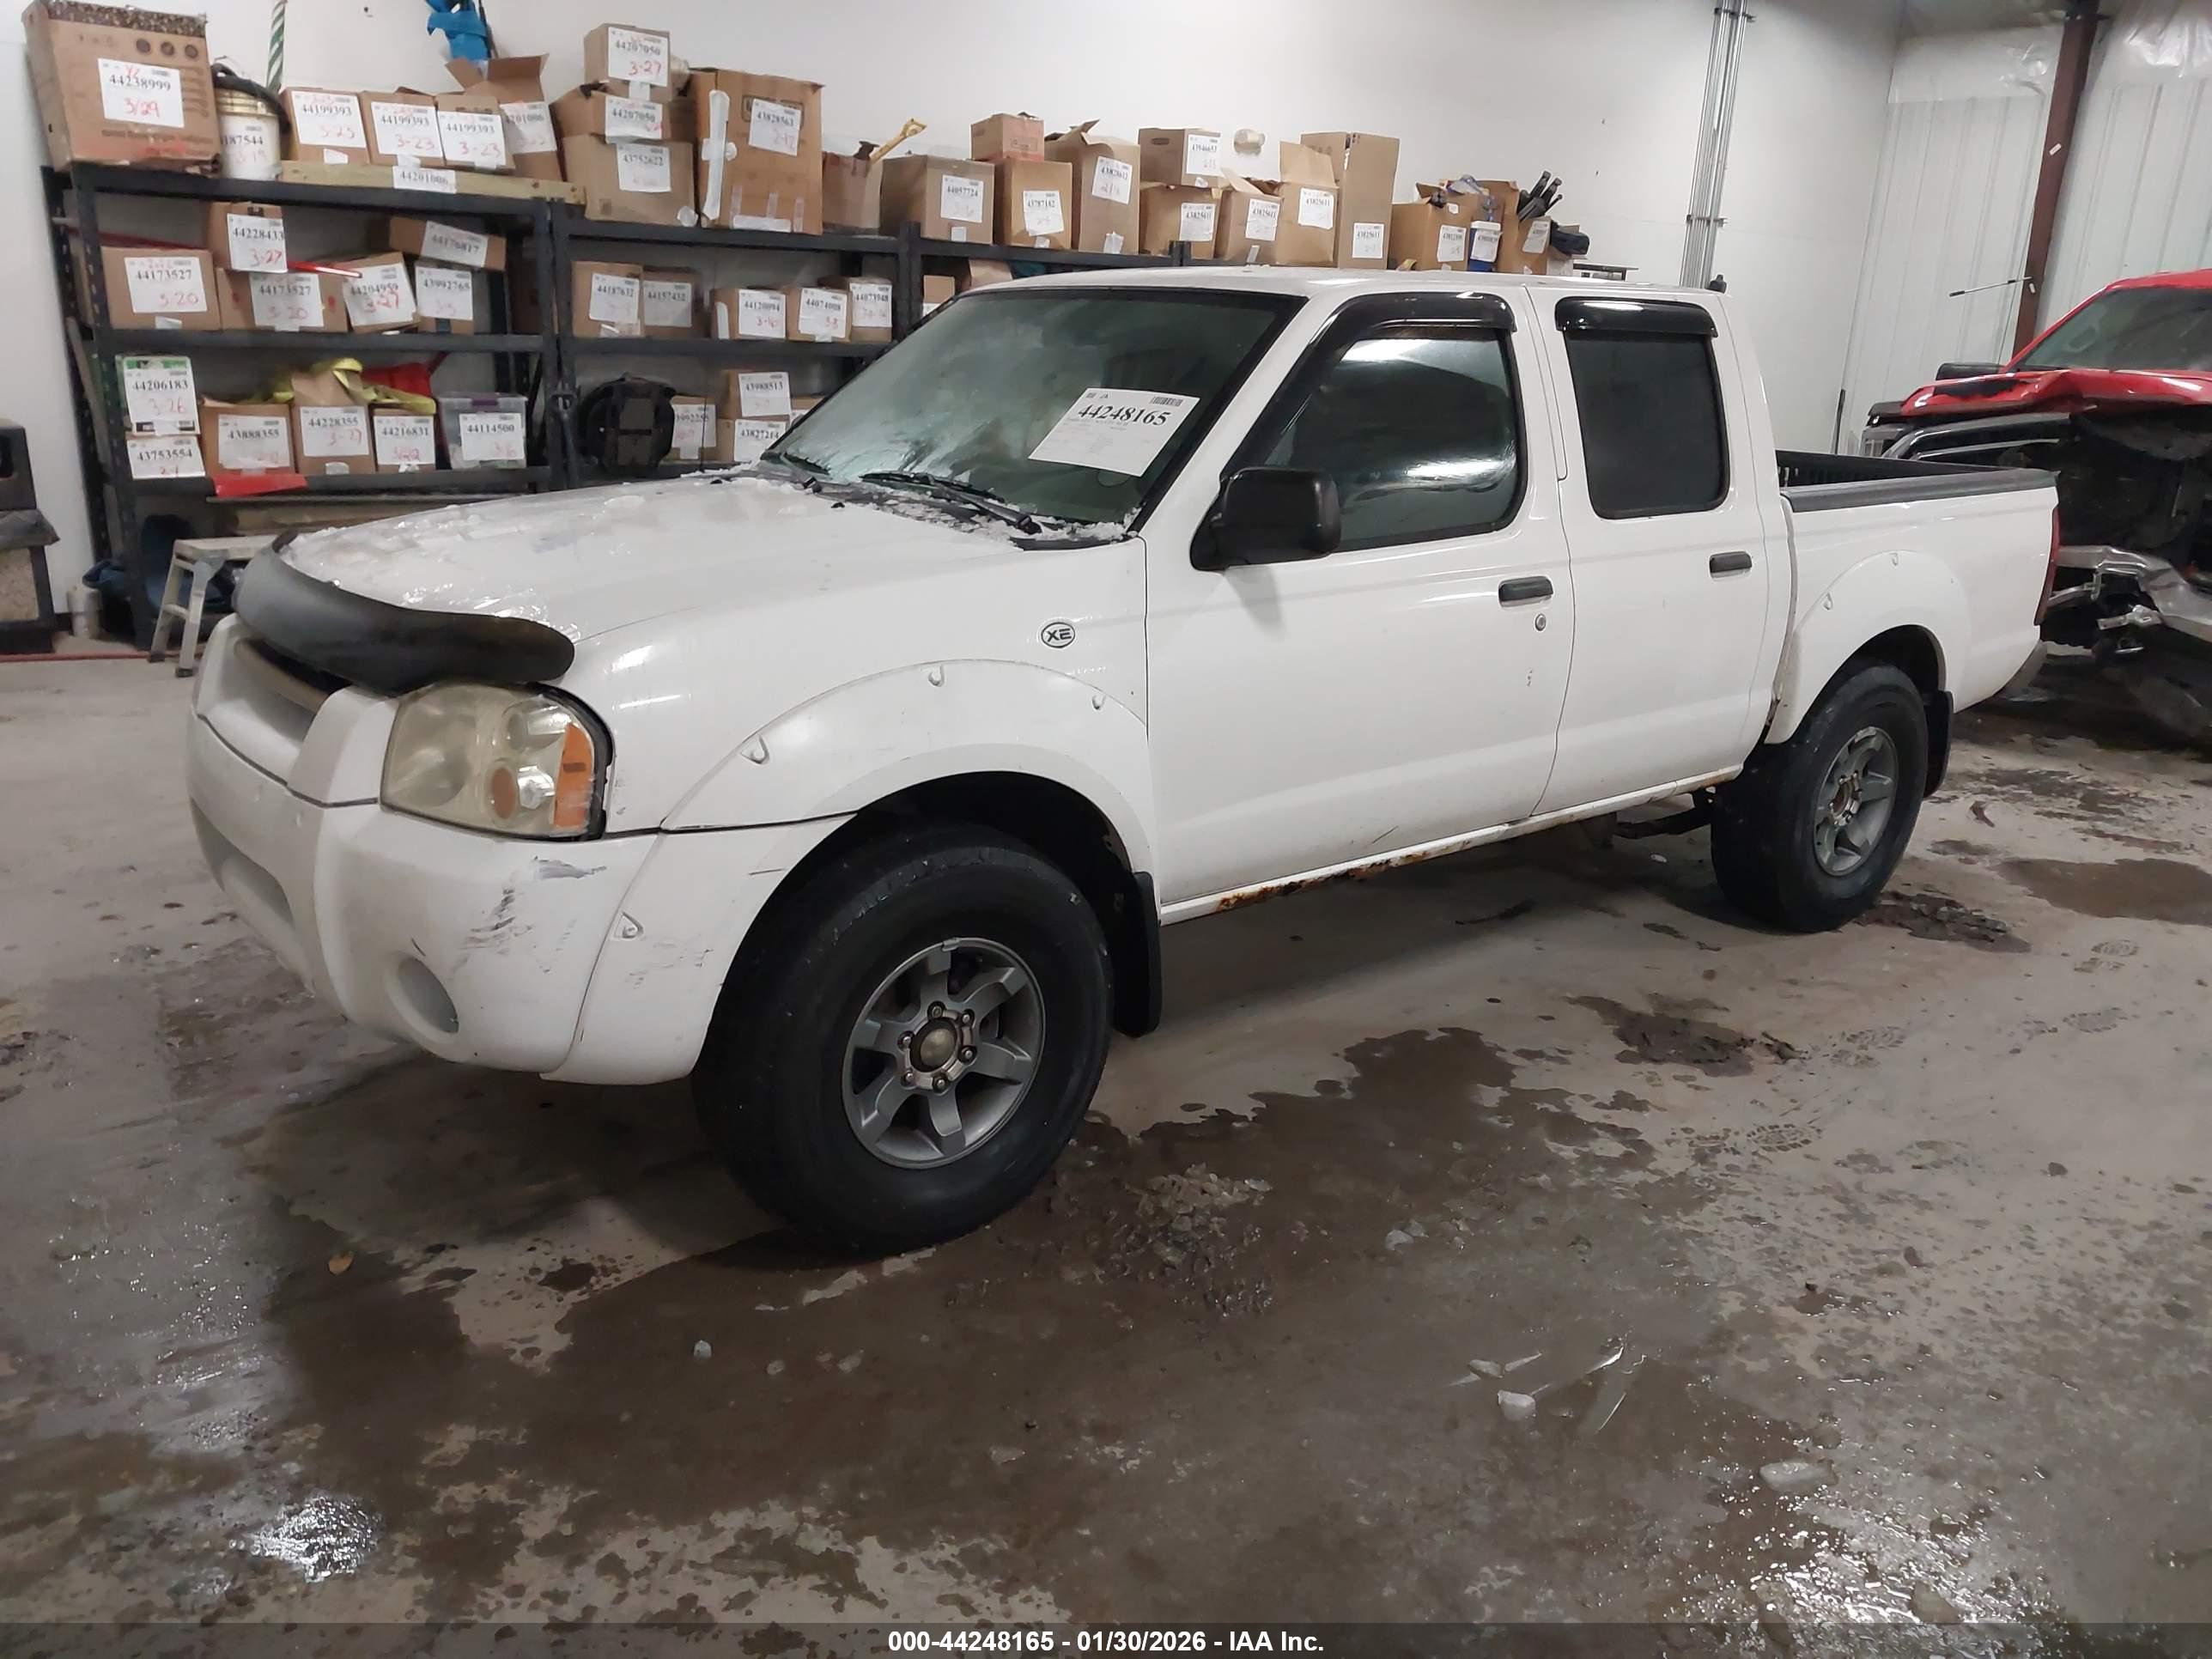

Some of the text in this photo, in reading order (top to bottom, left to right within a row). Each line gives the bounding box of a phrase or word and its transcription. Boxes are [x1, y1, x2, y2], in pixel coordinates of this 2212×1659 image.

[109, 74, 172, 91] 44238999
[302, 104, 353, 116] 44199393
[380, 114, 429, 127] 44199393
[446, 123, 495, 134] 44199393
[232, 227, 285, 241] 44228433
[136, 269, 192, 281] 44173527
[258, 285, 312, 297] 44173527
[131, 379, 189, 392] 44206183
[308, 416, 360, 428] 44228355
[1078, 404, 1171, 427] 44248165
[381, 427, 429, 437] 44216831
[137, 448, 193, 462] 43753554
[1047, 628, 1073, 642] XE
